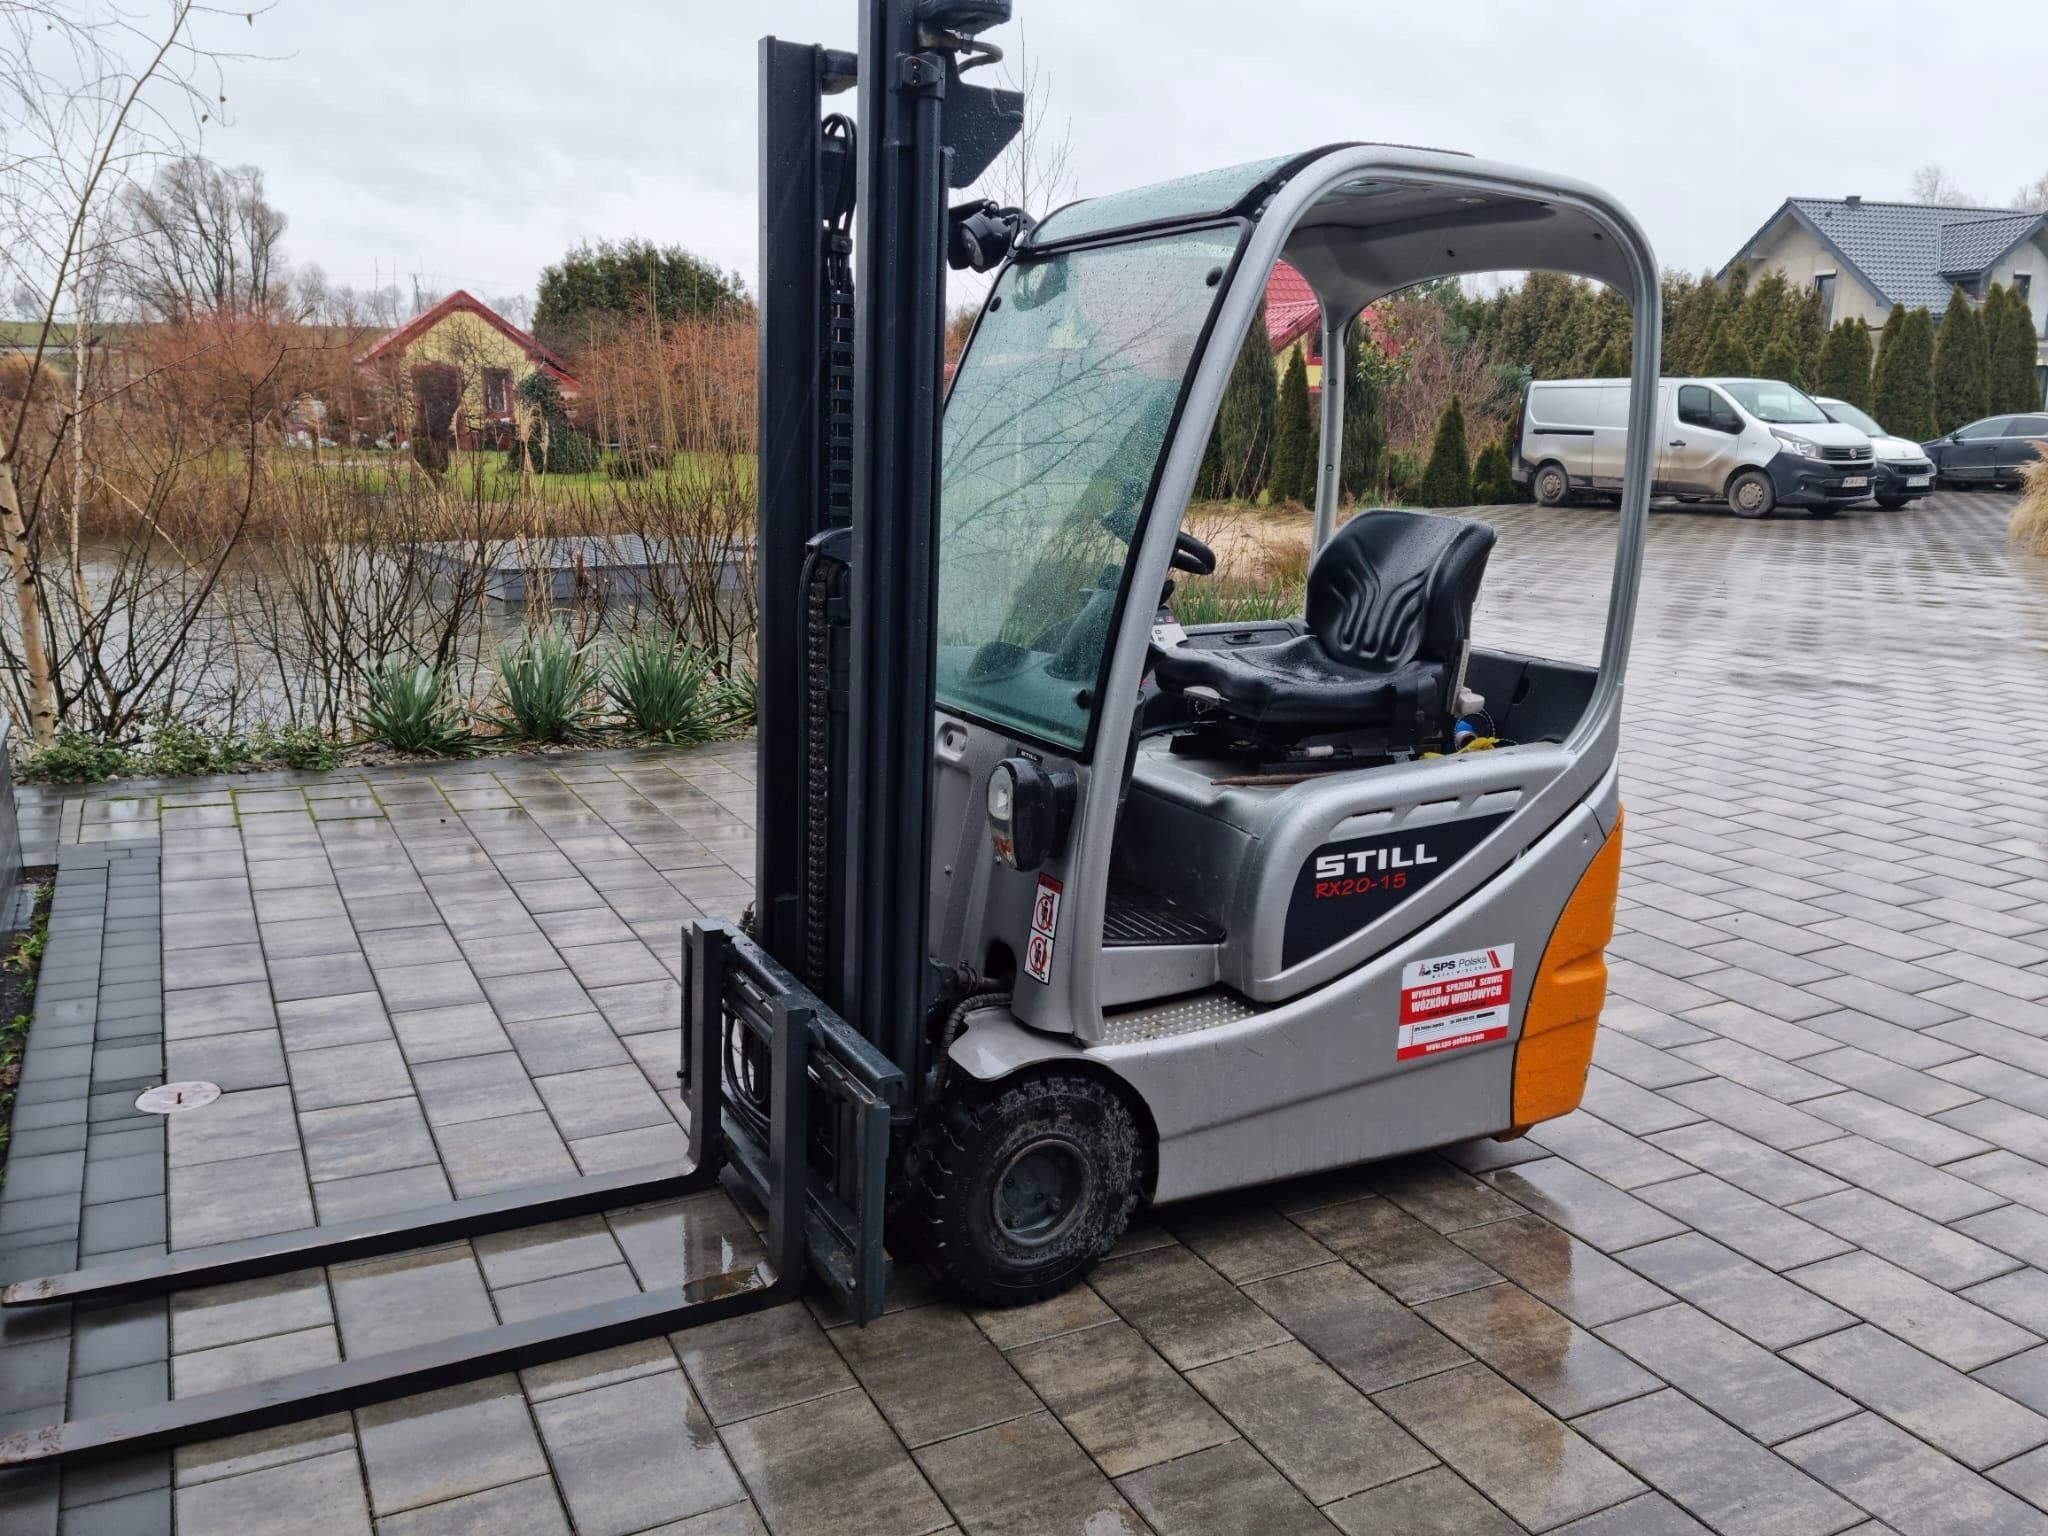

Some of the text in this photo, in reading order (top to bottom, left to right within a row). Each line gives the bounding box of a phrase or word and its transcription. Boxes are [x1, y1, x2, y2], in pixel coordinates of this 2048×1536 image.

[1020, 750, 1038, 761] STILL
[1315, 843, 1438, 879] STILL
[1315, 872, 1408, 899] RX20-15
[1432, 960, 1456, 973] SPS
[1458, 956, 1488, 968] Polska
